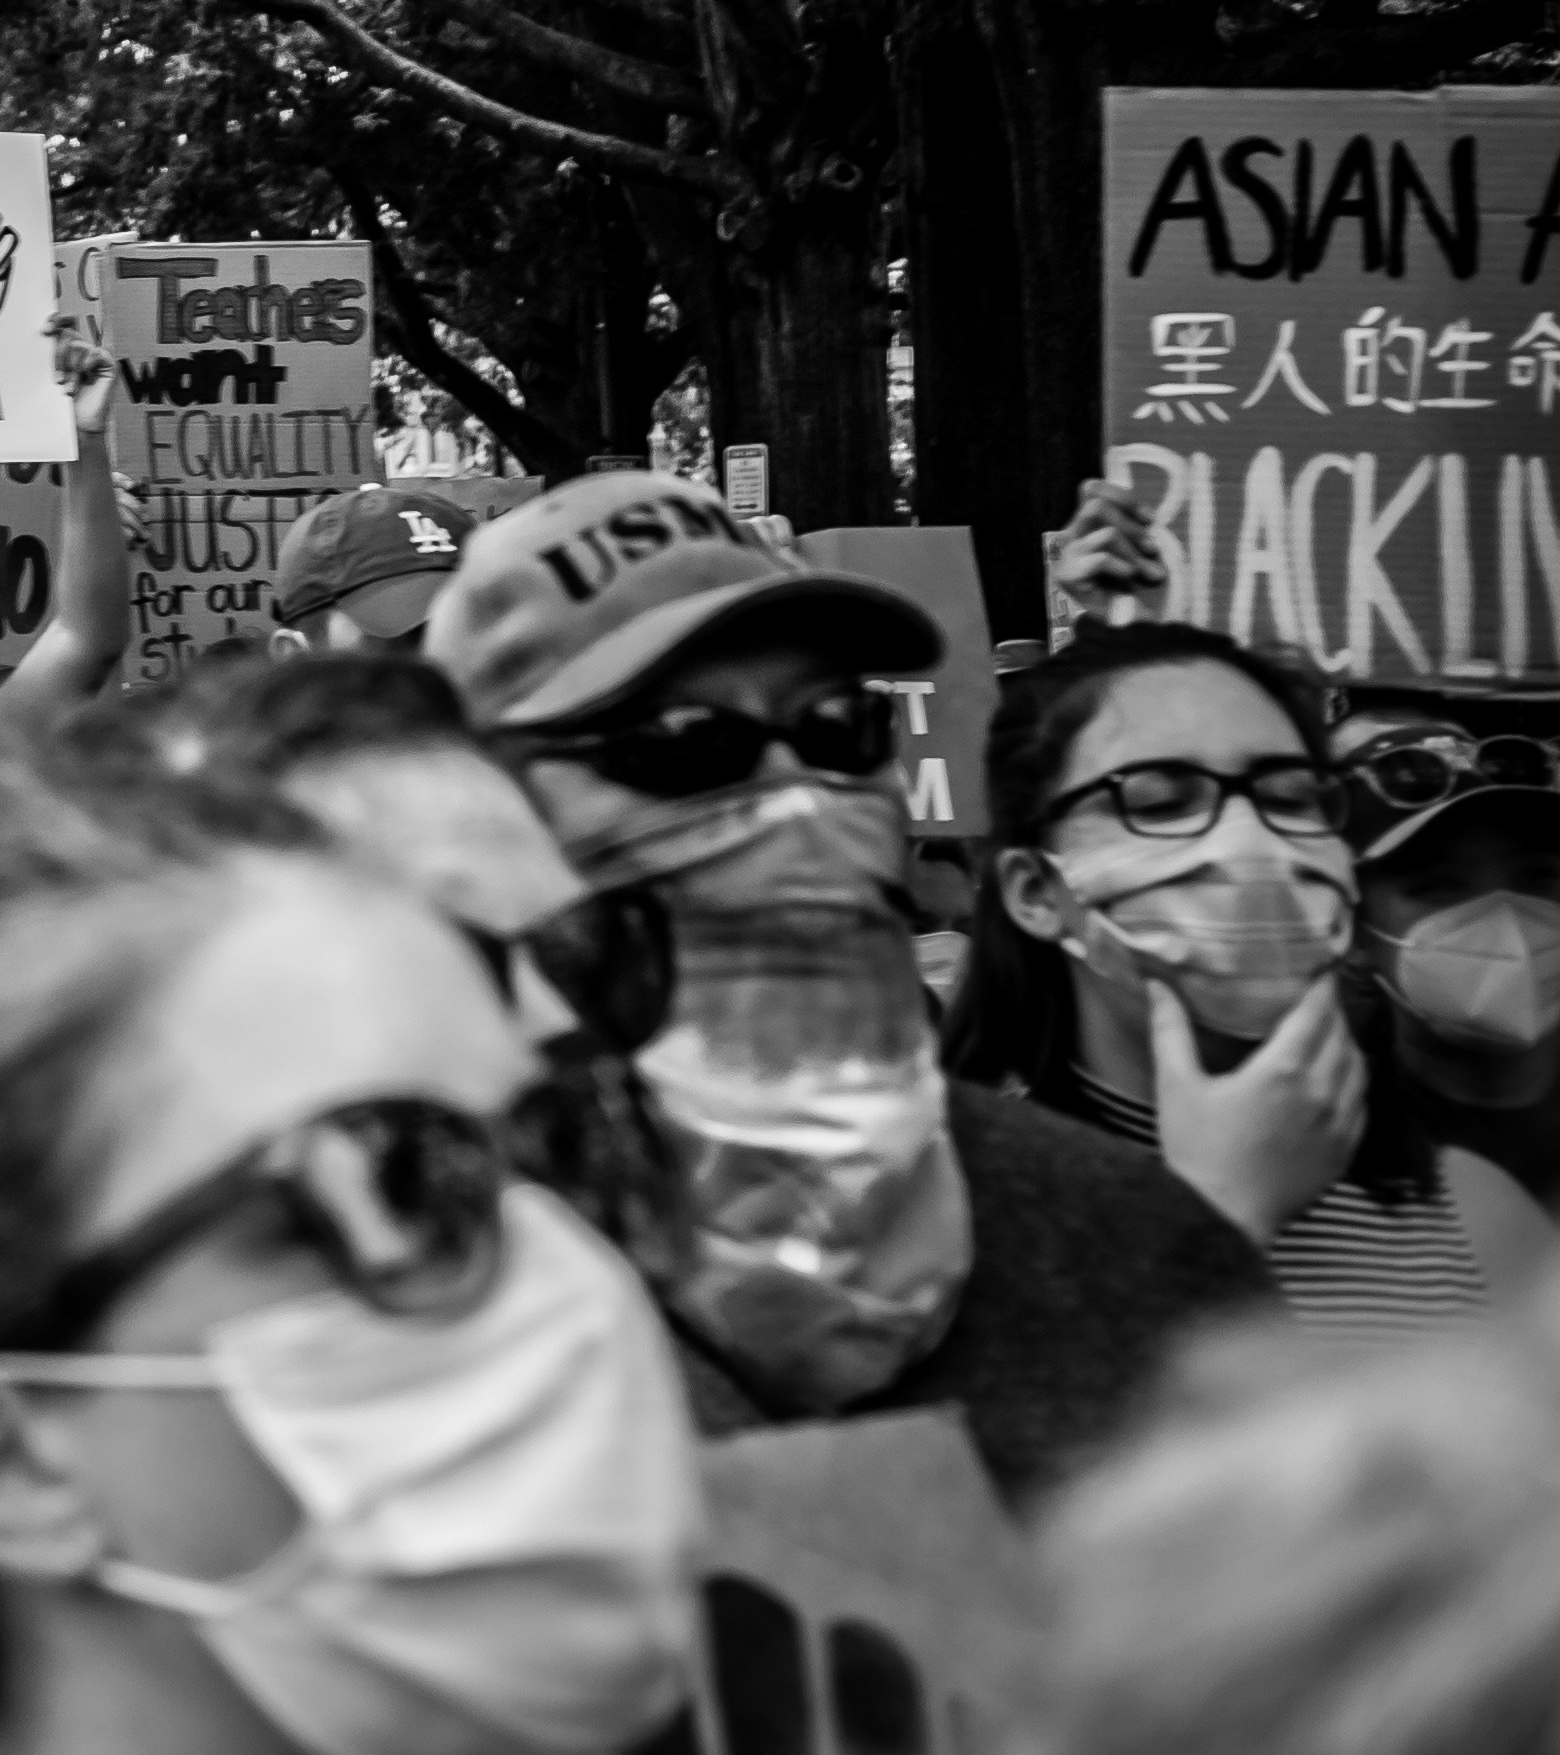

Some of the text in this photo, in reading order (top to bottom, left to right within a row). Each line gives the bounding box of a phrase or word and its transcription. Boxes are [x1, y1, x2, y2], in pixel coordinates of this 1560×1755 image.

[1128, 134, 1480, 282] ASIAN
[117, 344, 289, 408] want
[145, 403, 370, 484] EQUALITY
[398, 510, 458, 553] LA
[129, 571, 273, 634] for our
